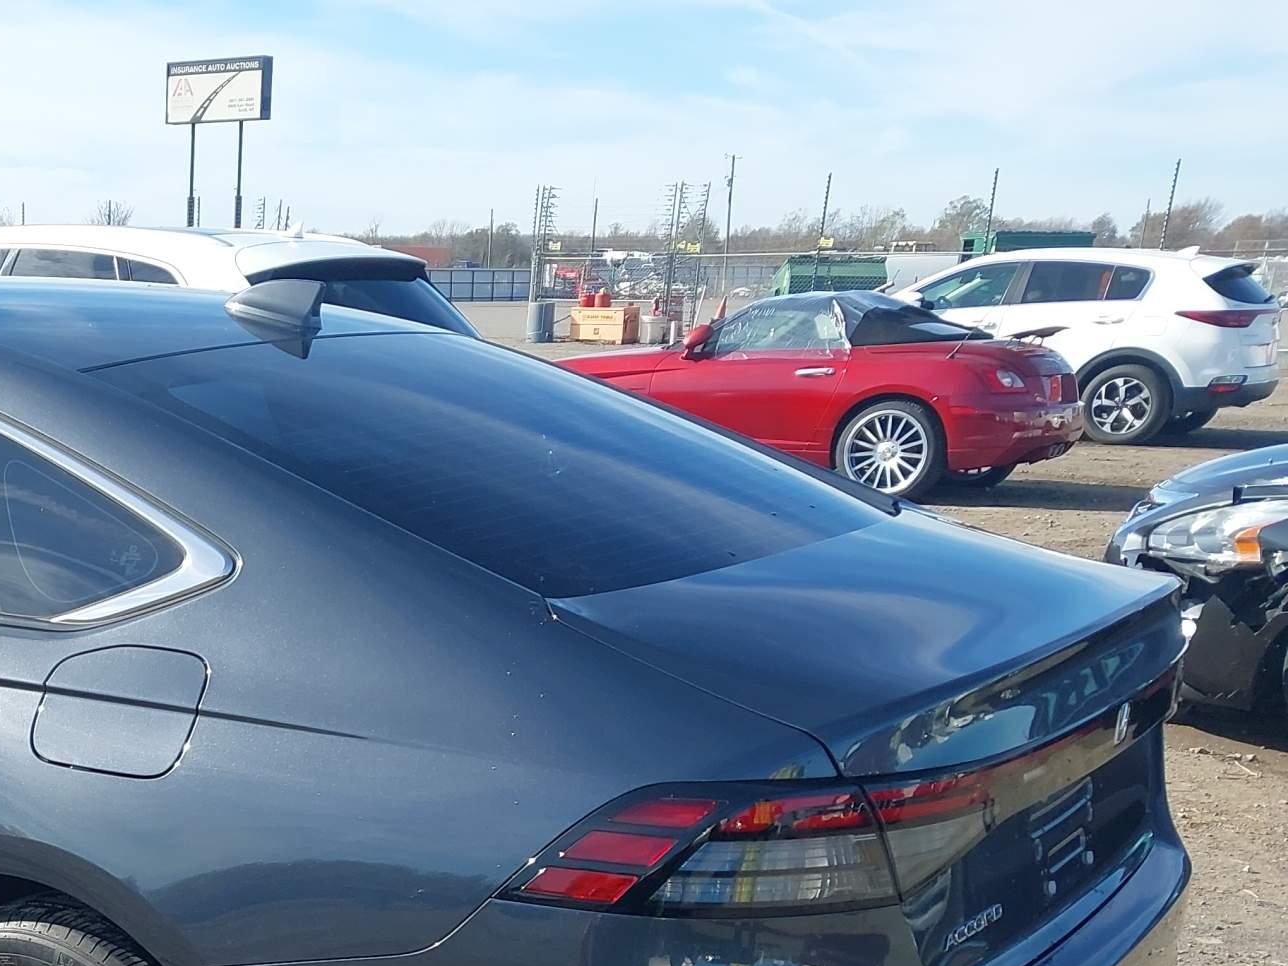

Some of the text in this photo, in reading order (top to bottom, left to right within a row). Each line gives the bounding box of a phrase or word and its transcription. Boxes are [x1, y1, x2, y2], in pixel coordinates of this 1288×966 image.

[171, 60, 260, 75] INSURANCE AUTO AUCTIONS
[943, 903, 1003, 953] ACCORD
